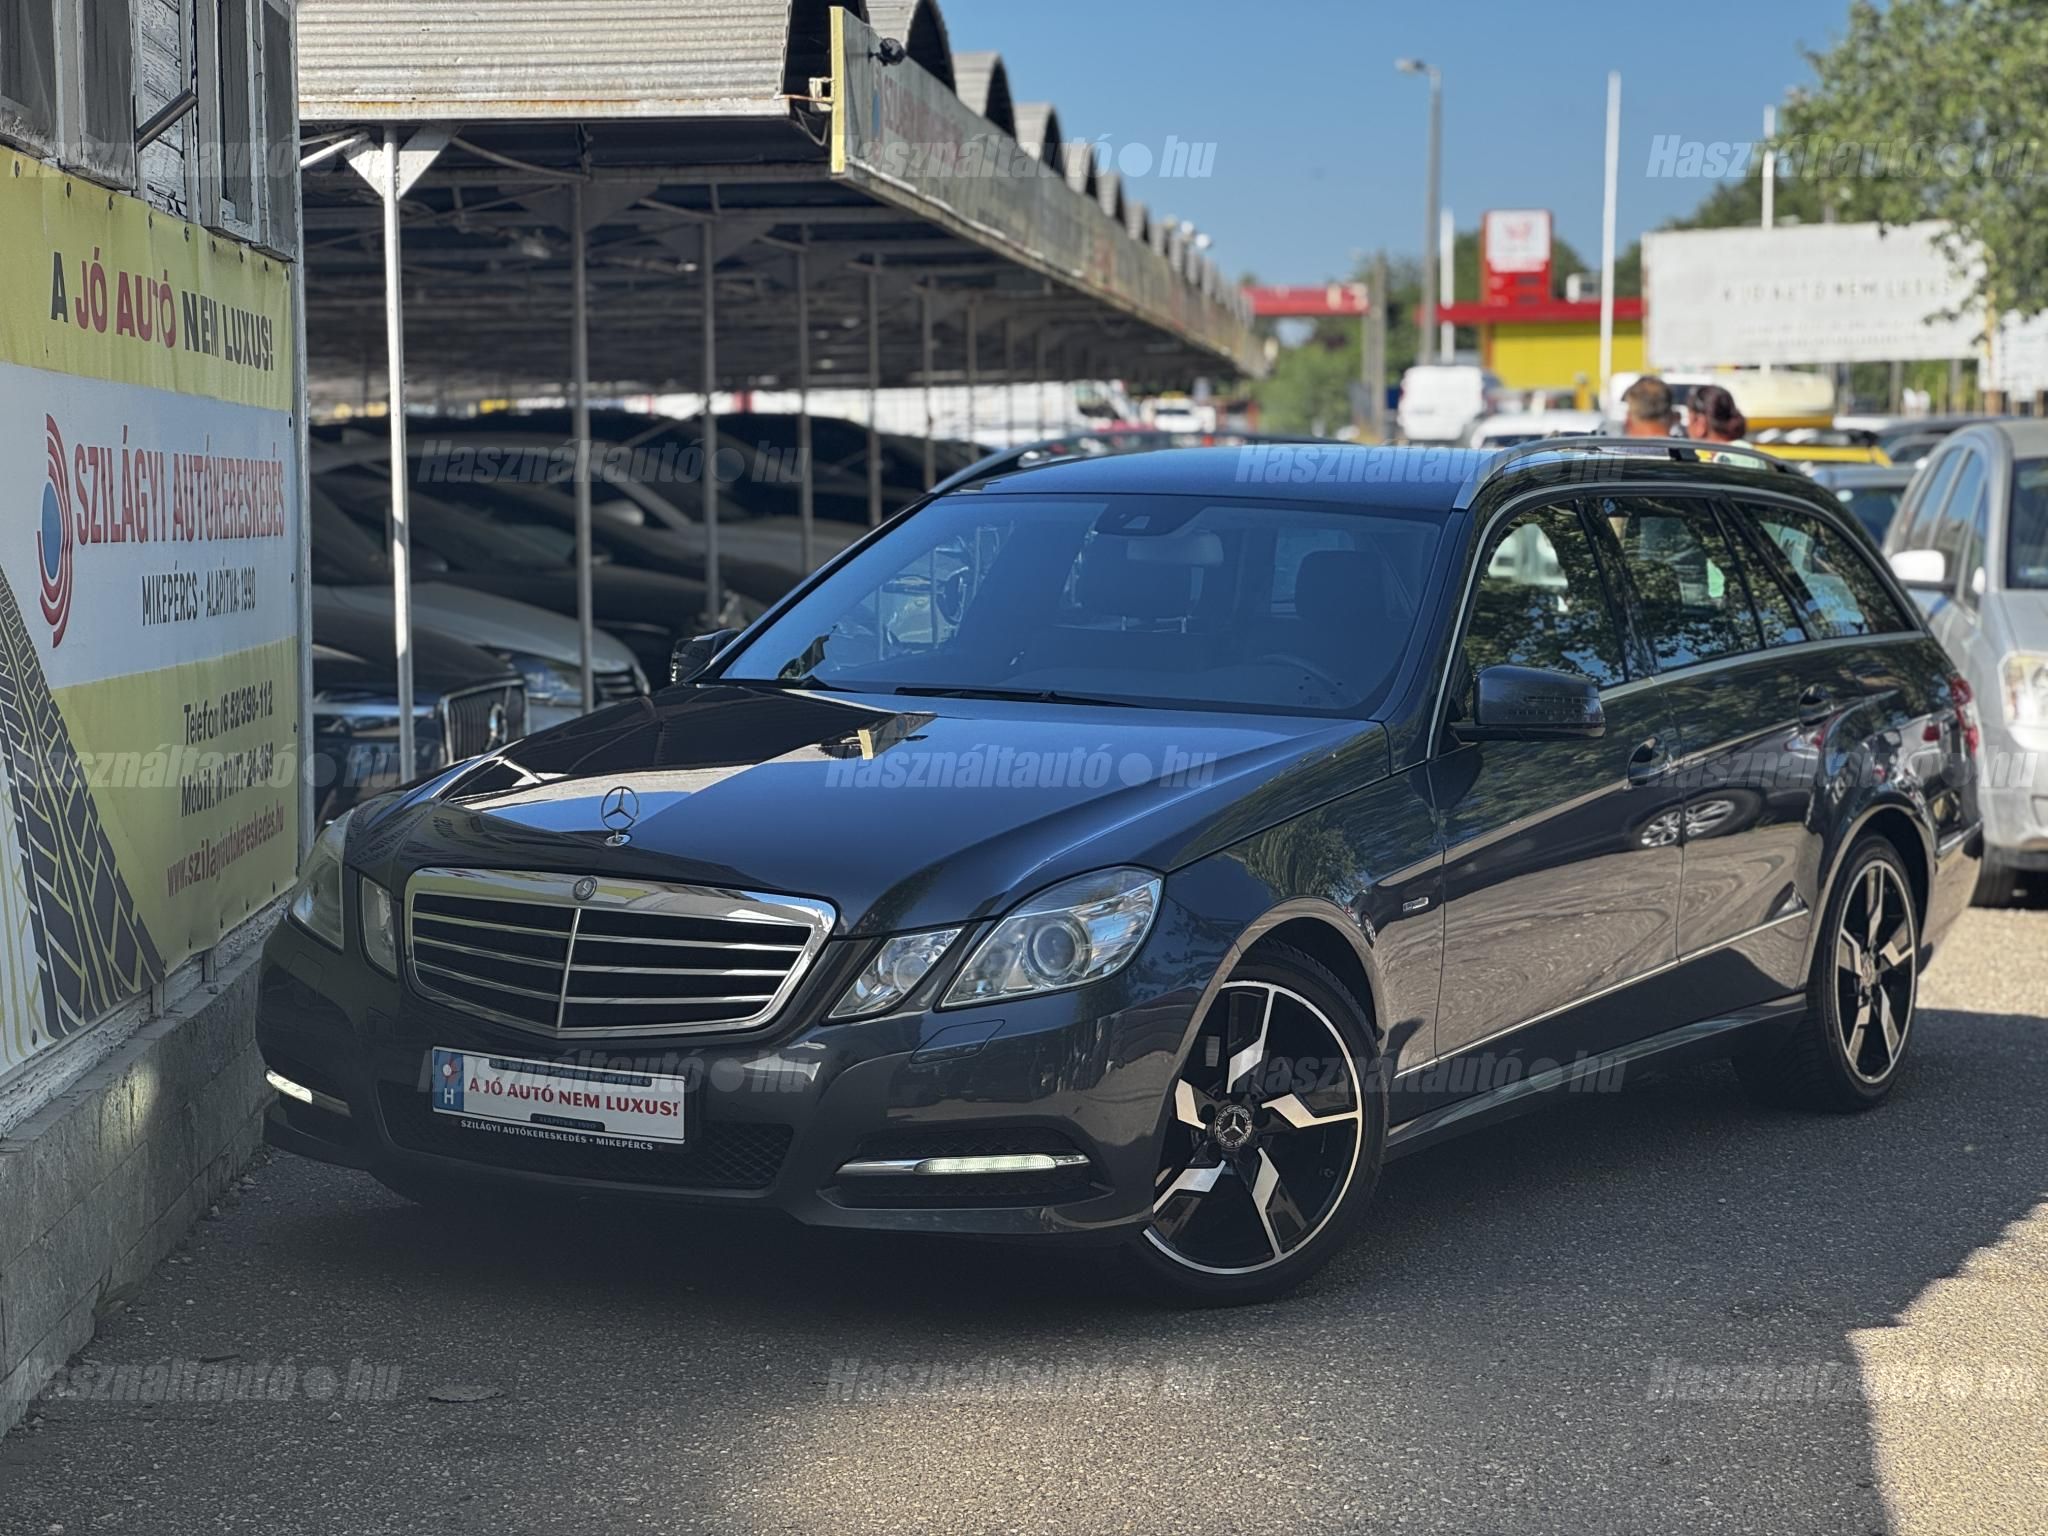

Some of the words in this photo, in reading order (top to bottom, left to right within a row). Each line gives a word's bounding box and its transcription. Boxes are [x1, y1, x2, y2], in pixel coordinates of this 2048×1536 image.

[51, 252, 68, 322] A
[75, 247, 107, 333] JÓ
[116, 269, 176, 348] AUTÓ
[182, 291, 219, 357] NEM
[222, 305, 273, 371] LUXUS!
[74, 425, 166, 545] SZILÁGYI
[172, 434, 285, 543] AUTÓKERESKEDÉS
[142, 560, 198, 626] MIKEPÉRCS
[443, 1089, 454, 1105] H
[469, 1077, 479, 1092] A
[484, 1074, 503, 1096] JÓ
[507, 1083, 554, 1103] AUTÓ
[559, 1091, 600, 1110] NEM
[606, 1095, 679, 1117] LUXUS!
[461, 1119, 501, 1133] SZILÁGYI
[503, 1125, 587, 1144] AUTÓKERESKEDÉS
[596, 1136, 654, 1151] MIKEPÉRCS
